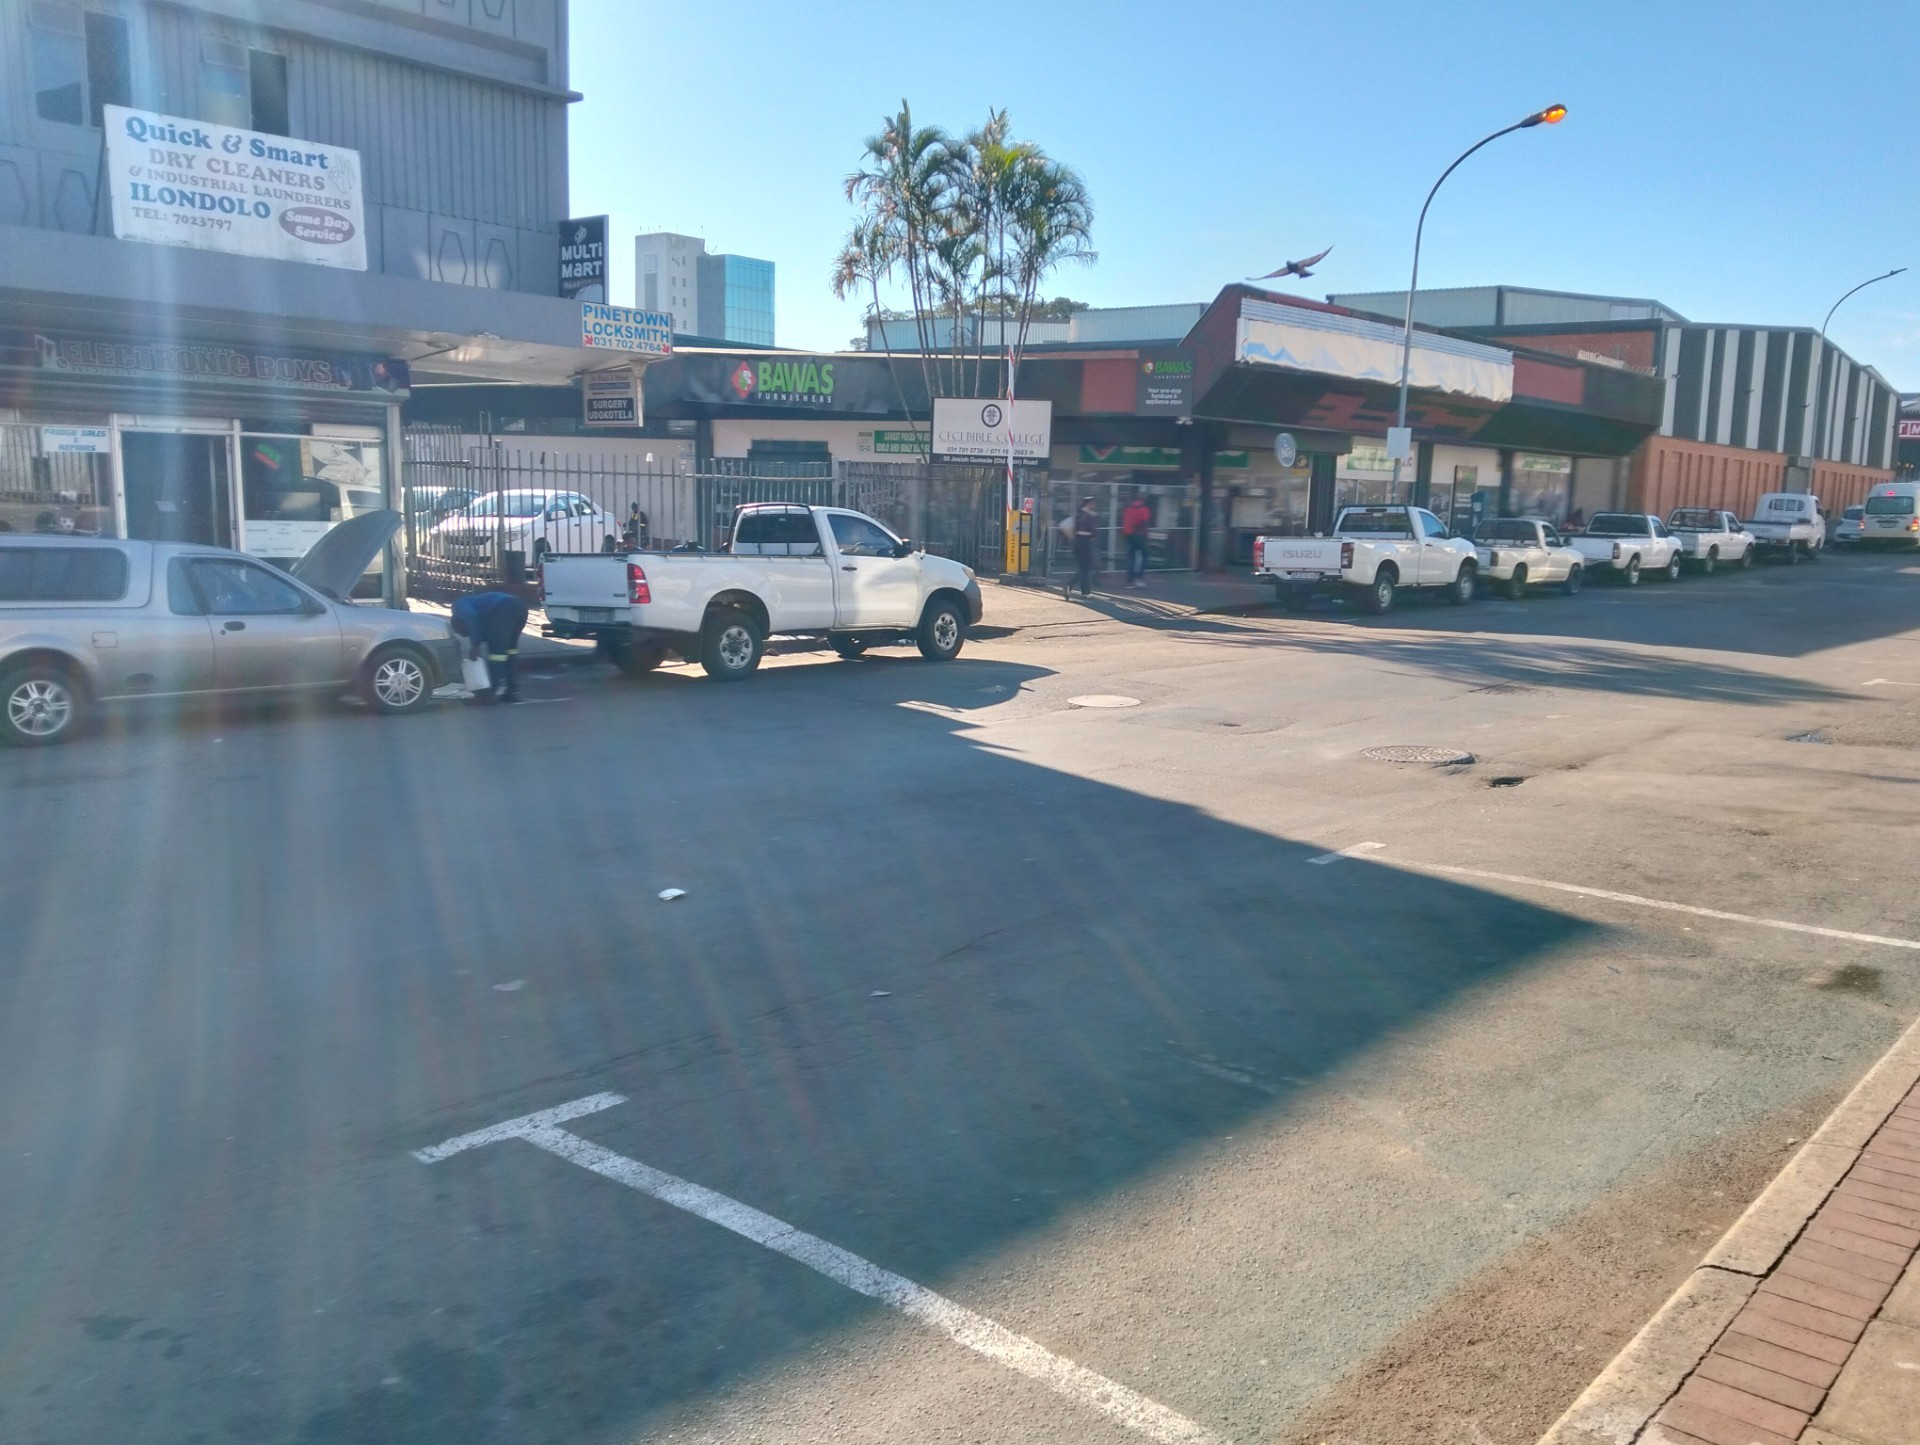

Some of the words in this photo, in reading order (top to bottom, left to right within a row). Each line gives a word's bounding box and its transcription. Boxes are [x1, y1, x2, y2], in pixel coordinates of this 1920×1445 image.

[125, 117, 212, 150] Quick
[221, 134, 242, 153] &
[250, 139, 328, 169] Smart
[149, 149, 197, 170] DRY
[206, 157, 325, 191] CLEANERS
[129, 166, 142, 177] &
[148, 169, 248, 194] INDUSTRIAL
[253, 186, 351, 210] LAUNDERERS
[130, 182, 271, 219] ILONDOLO
[132, 207, 168, 221] TEL:
[173, 214, 232, 231] 7023797
[285, 211, 322, 228] Same
[324, 216, 350, 231] Day
[295, 226, 343, 242] Service
[583, 303, 669, 328] PINETOWN
[583, 320, 670, 343] LOCKSMITH
[594, 337, 612, 347] 031
[615, 339, 634, 349] 702
[636, 342, 661, 352] 4764
[60, 341, 250, 377] ELECTRONIC
[255, 356, 334, 383] BOYS
[1155, 360, 1192, 373] BAWAS
[758, 361, 834, 394] BAWAS
[592, 400, 628, 409] SURGERY
[758, 392, 832, 403] FURNISHERS
[966, 432, 992, 442] BIBLE
[1282, 549, 1322, 559] ISUZU
